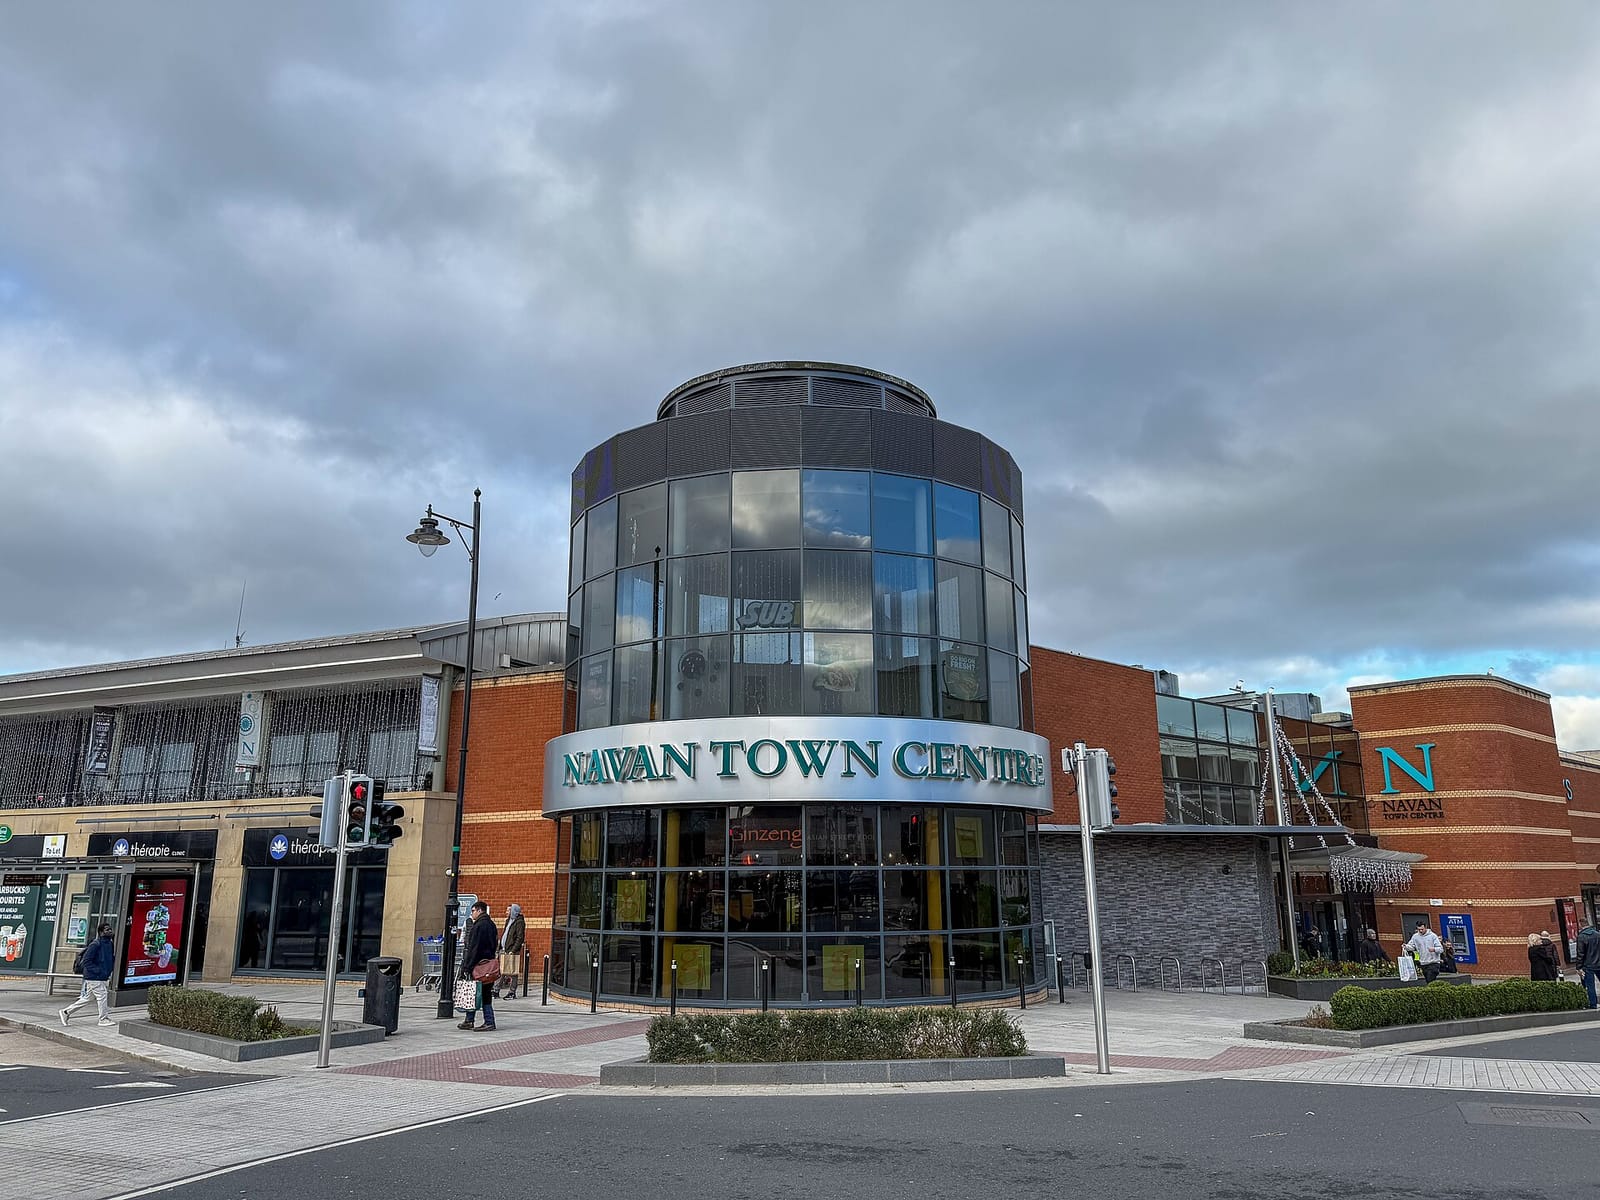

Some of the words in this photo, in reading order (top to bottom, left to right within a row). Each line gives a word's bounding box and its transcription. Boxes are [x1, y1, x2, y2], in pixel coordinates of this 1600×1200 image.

[242, 741, 255, 755] N
[562, 742, 699, 786] NAVAN
[709, 739, 883, 778] TOWN
[893, 741, 1045, 787] CENTRE
[1375, 743, 1437, 794] N
[1382, 798, 1443, 812] NAVAN
[1383, 812, 1408, 820] TOWN
[1410, 811, 1445, 819] CENTRE
[732, 825, 801, 848] Ginzeng
[130, 842, 170, 857] thérapie
[291, 838, 327, 857] thérap
